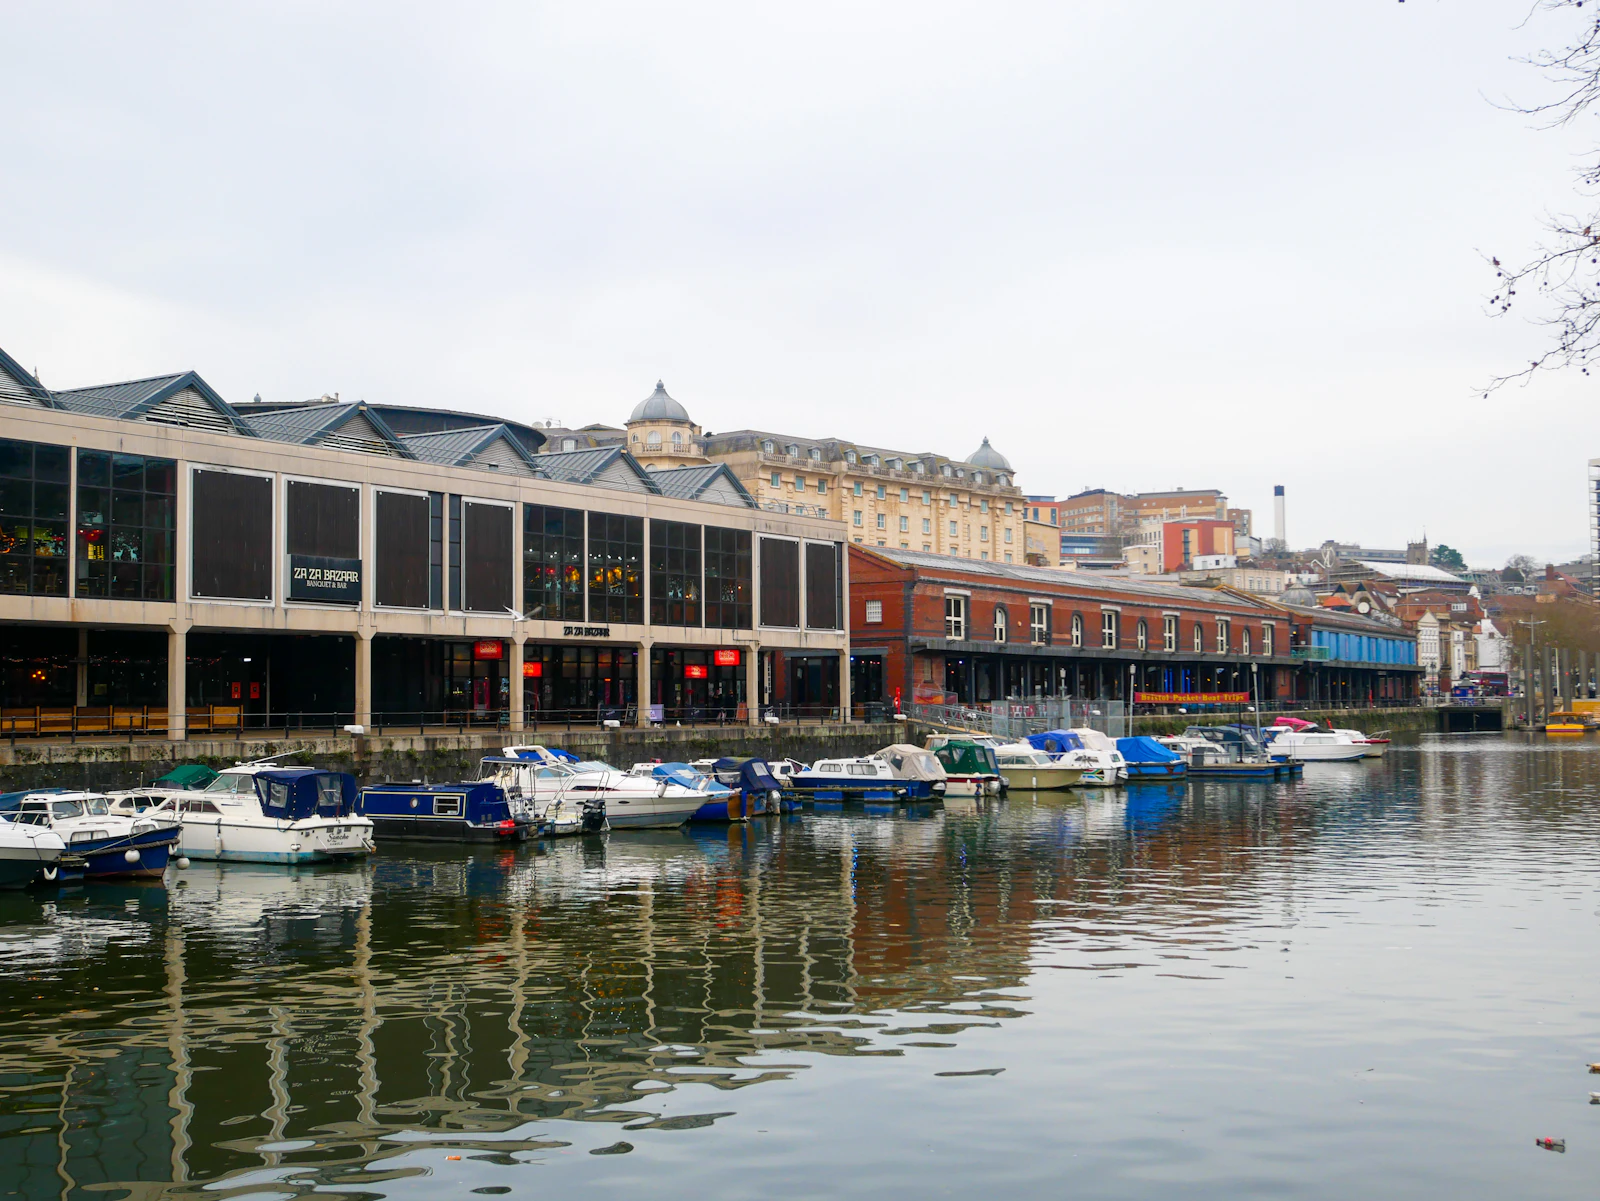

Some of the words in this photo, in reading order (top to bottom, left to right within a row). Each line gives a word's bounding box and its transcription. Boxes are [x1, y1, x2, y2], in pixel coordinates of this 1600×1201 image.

[294, 567, 307, 579] ZA
[309, 568, 321, 580] ZA
[324, 569, 359, 582] BAZAAR
[307, 580, 331, 588] BANQUET
[564, 626, 573, 636] ZA
[574, 626, 583, 637] ZA
[584, 627, 610, 637] BAZAAR
[1224, 694, 1244, 702] Trips
